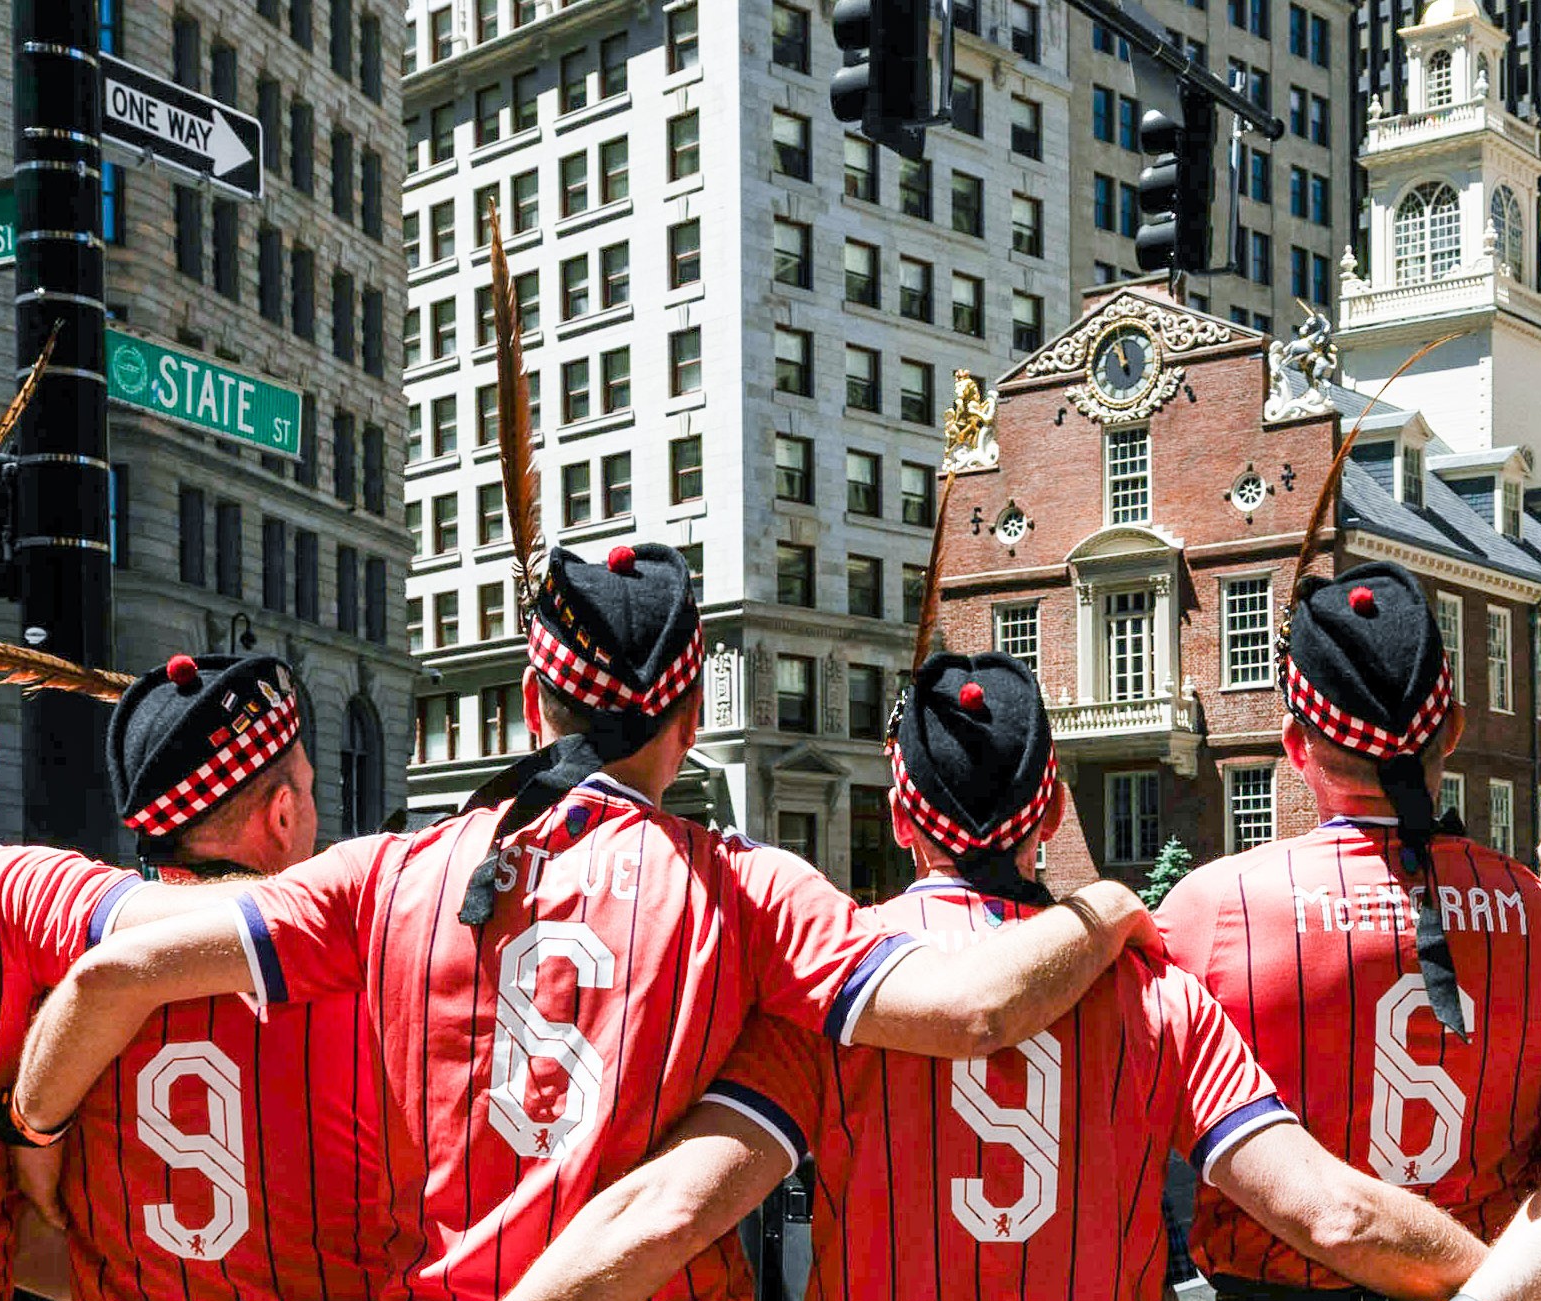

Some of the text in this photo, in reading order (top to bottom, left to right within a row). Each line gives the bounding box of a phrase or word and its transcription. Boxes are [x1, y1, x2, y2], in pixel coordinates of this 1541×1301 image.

[113, 86, 213, 151] ONE WAY
[158, 355, 291, 445] STATE ST
[488, 920, 615, 1160] 6
[950, 1032, 1062, 1243] 9
[1368, 973, 1475, 1186] 6
[136, 1041, 251, 1262] 9
